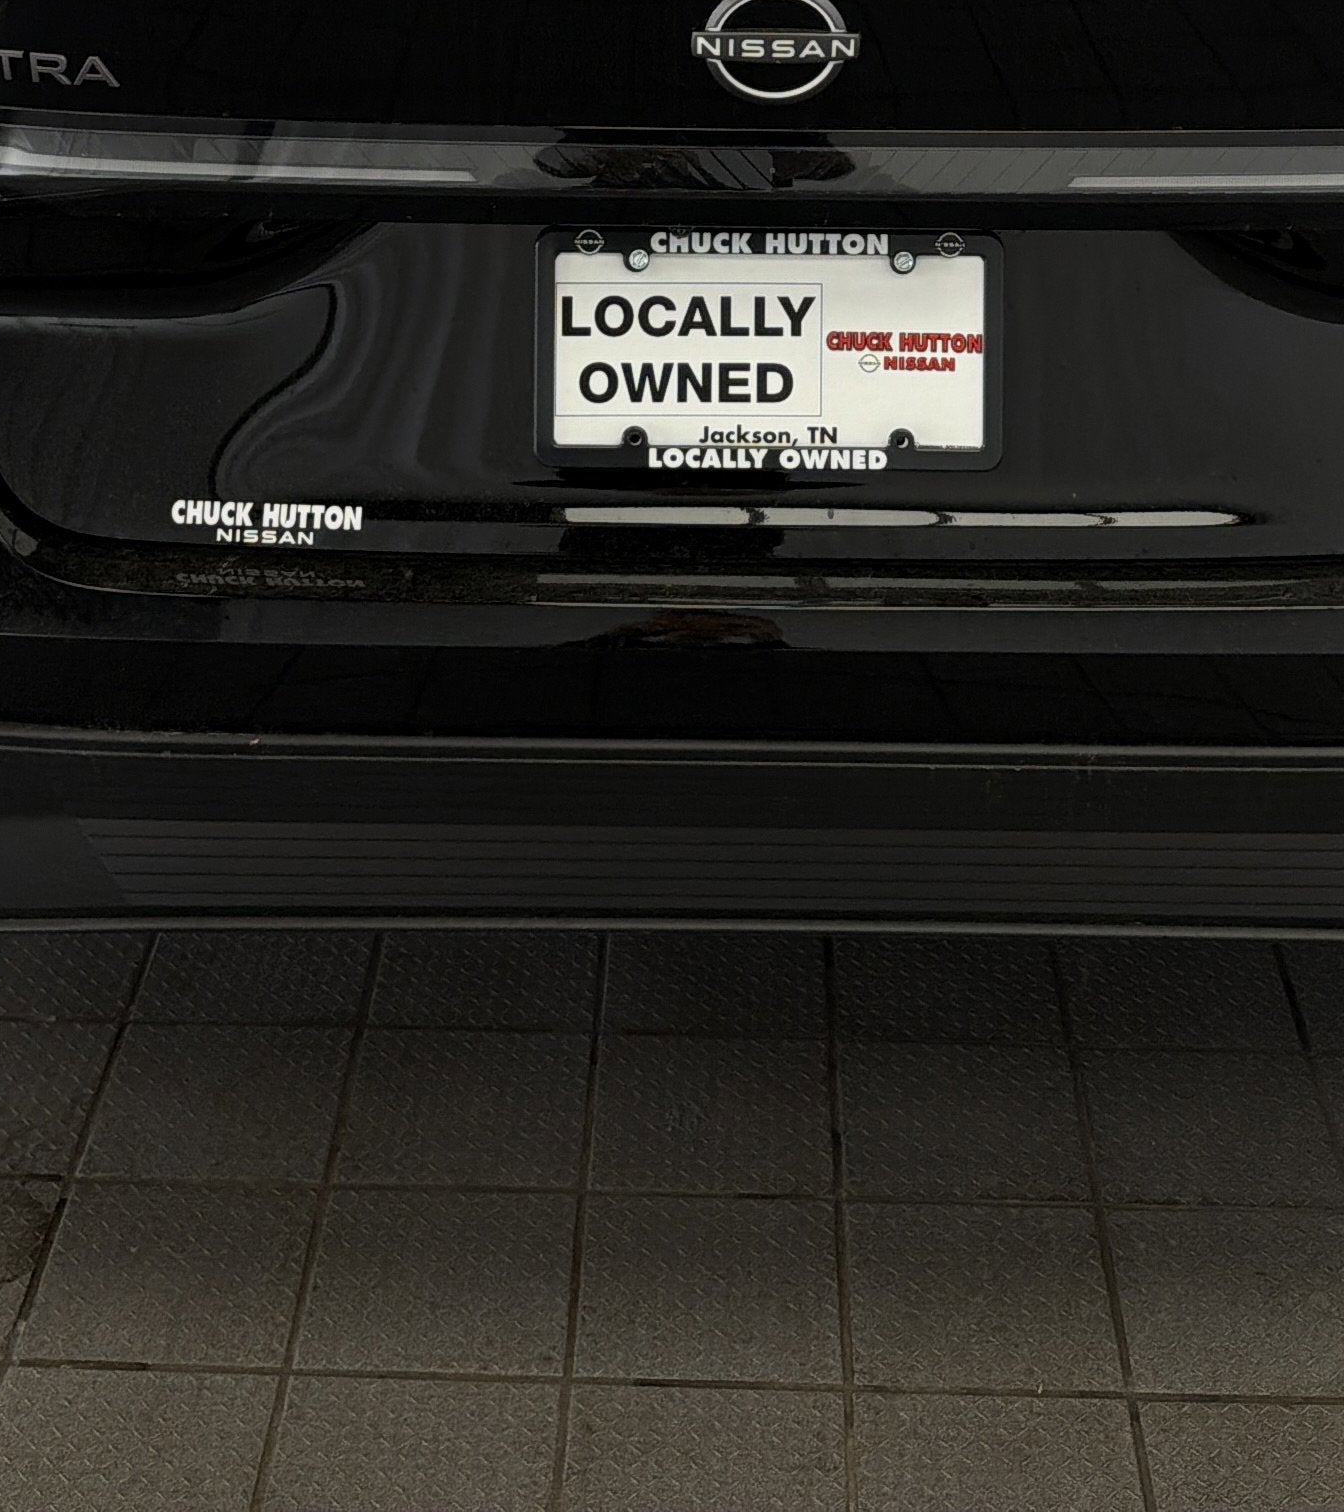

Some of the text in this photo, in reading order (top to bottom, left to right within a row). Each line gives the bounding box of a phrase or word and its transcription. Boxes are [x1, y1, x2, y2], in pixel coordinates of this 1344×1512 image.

[696, 36, 856, 58] NISSAN
[650, 231, 889, 256] CHUCK HUTTON
[561, 295, 817, 337] LOCALLY
[826, 330, 983, 354] CHUCK HUTTON
[884, 355, 956, 372] NISSAN
[578, 361, 794, 404] OWNED
[699, 424, 838, 448] Jackson, TN
[648, 447, 888, 470] LOCALLY OWNED
[171, 499, 363, 530] CHUCK HUTTON
[216, 528, 314, 546] NISSAN
